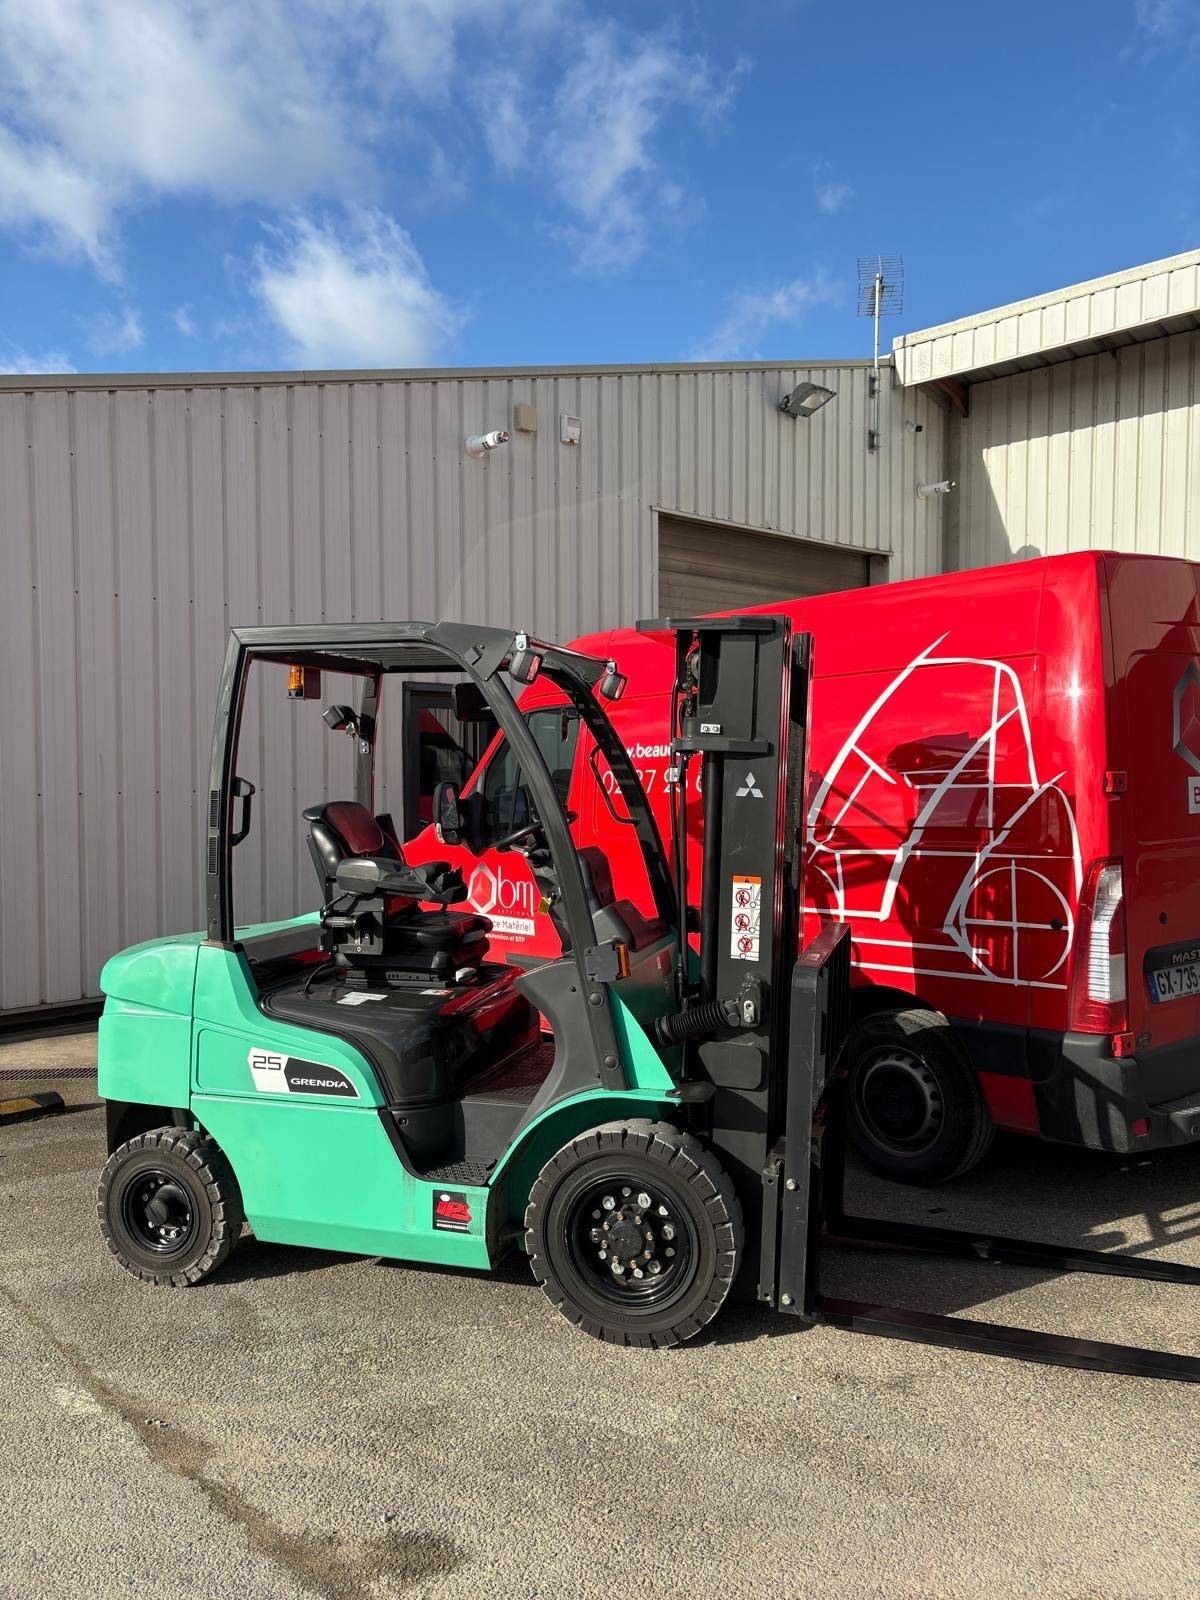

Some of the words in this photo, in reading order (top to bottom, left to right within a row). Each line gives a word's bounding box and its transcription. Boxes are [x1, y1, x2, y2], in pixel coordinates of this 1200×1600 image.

[502, 920, 531, 932] Matériel
[253, 1055, 281, 1070] 25
[290, 1078, 348, 1088] GRENDIA
